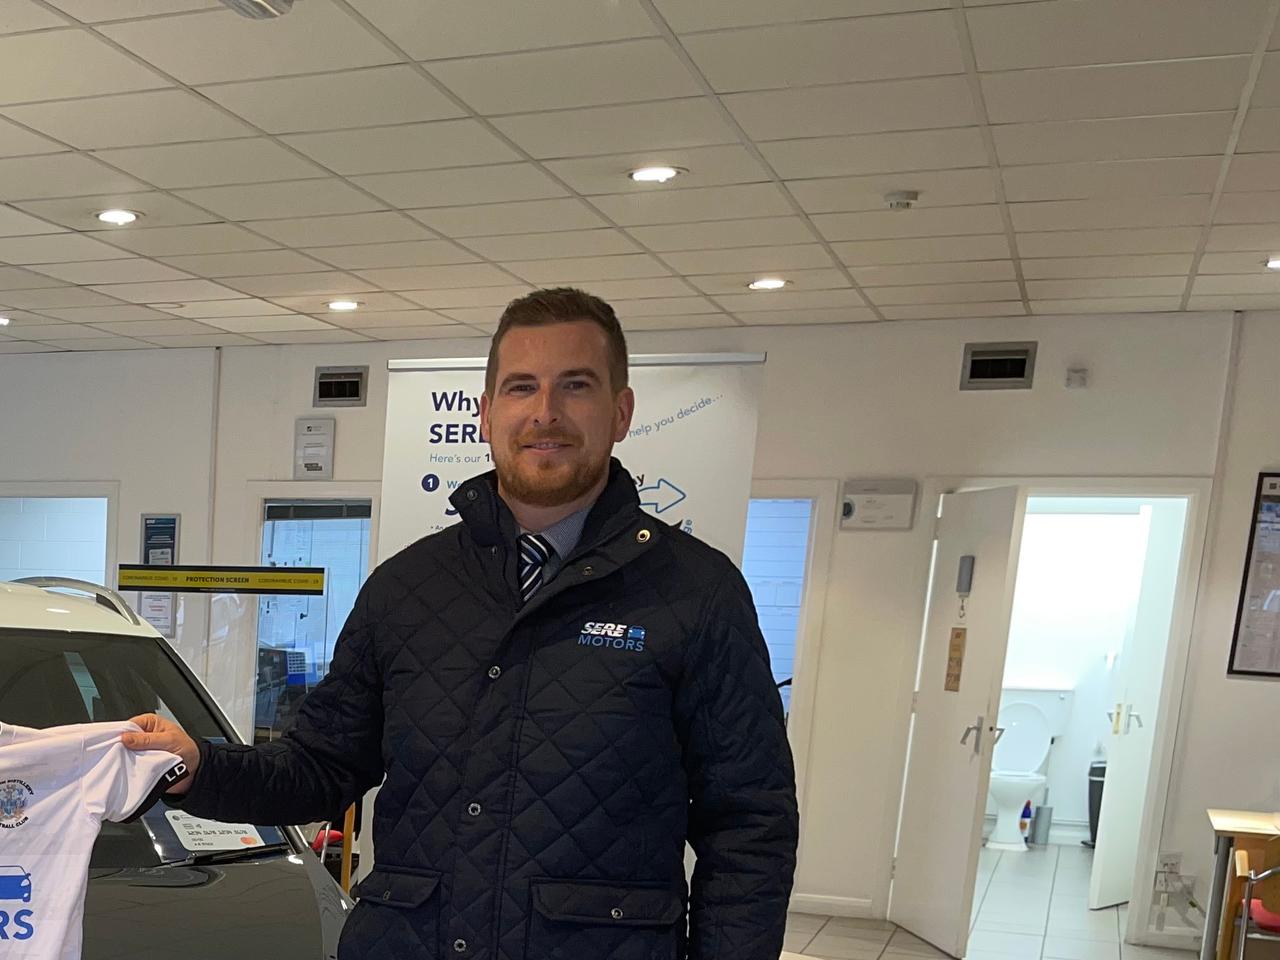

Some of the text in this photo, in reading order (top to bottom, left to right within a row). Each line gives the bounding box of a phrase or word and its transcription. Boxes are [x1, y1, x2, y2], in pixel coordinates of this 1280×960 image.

[431, 390, 481, 417] Why
[654, 416, 675, 432] you
[429, 453, 461, 463] Here's
[464, 455, 481, 463] our
[186, 575, 250, 584] PROTECTION SCREEN
[580, 621, 628, 637] SERE
[578, 635, 645, 652] MOTORS
[165, 763, 187, 782] LD
